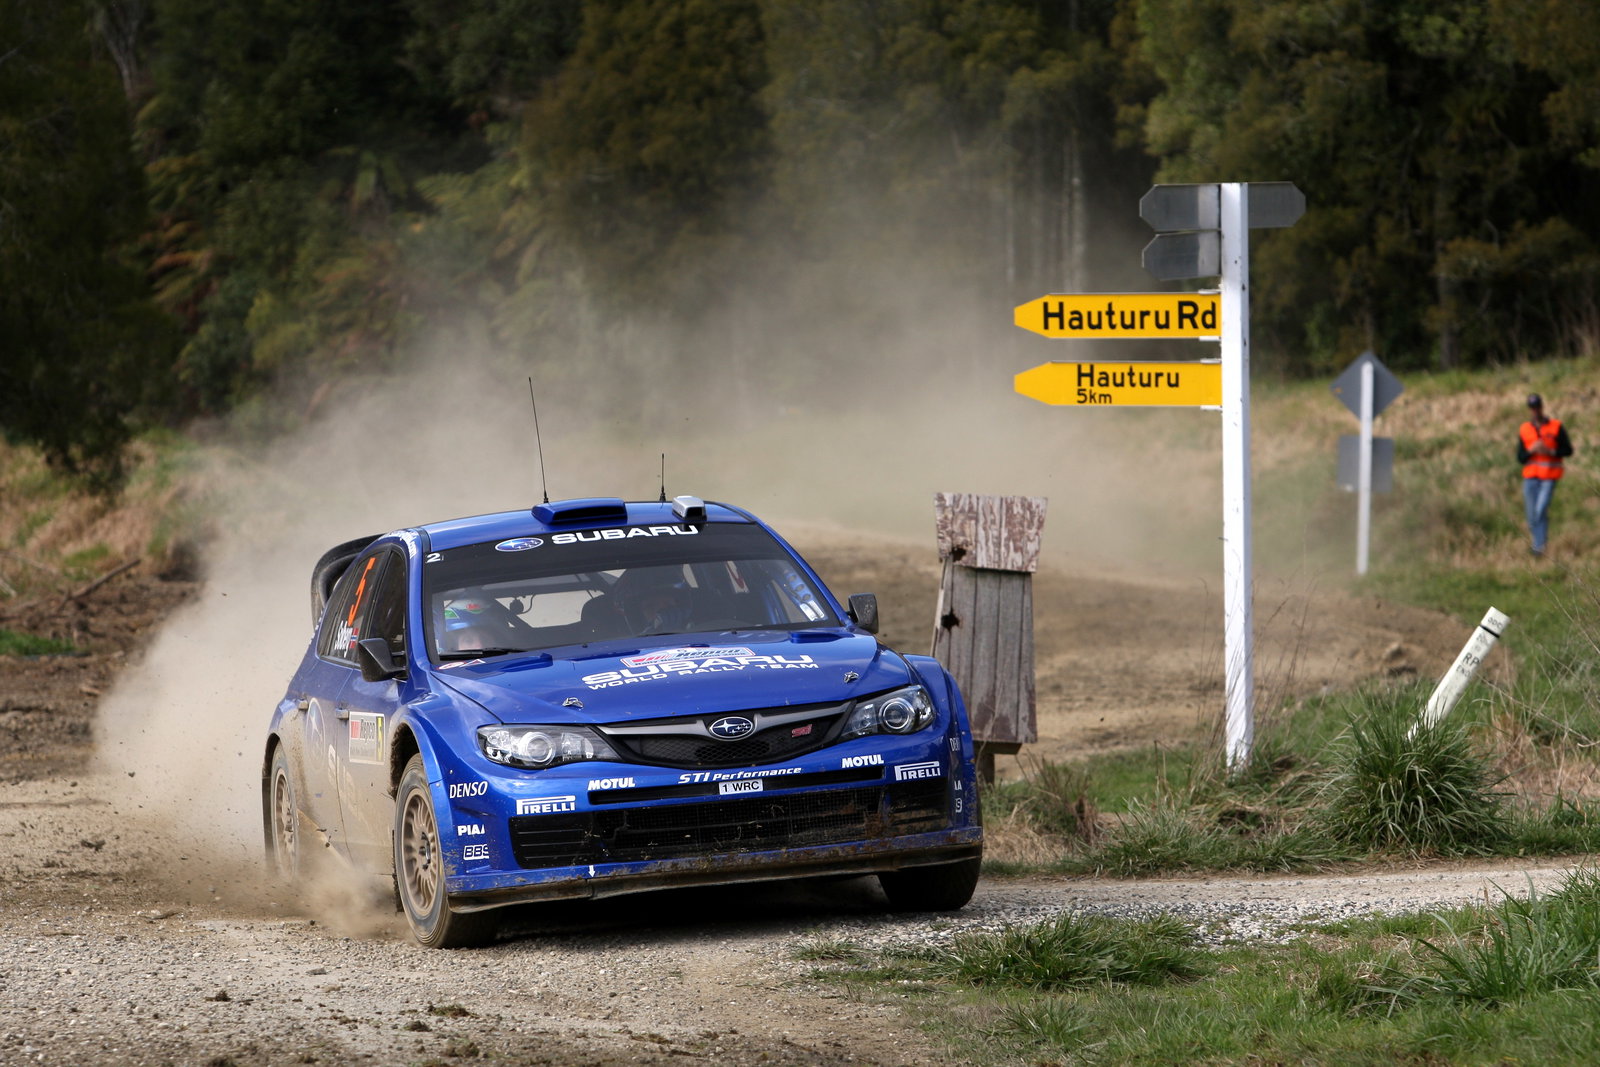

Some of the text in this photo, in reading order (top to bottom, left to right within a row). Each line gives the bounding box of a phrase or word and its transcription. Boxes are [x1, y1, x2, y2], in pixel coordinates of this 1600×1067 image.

[1043, 300, 1217, 330] Hauturu Rd
[1076, 364, 1180, 387] Hauturu
[1076, 388, 1112, 404] 5km
[551, 525, 699, 544] SUBARU
[581, 655, 815, 686] SUBARU
[588, 662, 819, 690] WORLD RALLY TEAM
[841, 754, 885, 768] MOTUL
[678, 767, 802, 785] STI Performance
[894, 761, 941, 781] PIRELLI
[449, 781, 489, 799] DENSO
[588, 777, 636, 791] MOTUL
[722, 781, 760, 793] 1 WRC
[516, 795, 576, 815] PIRELLI
